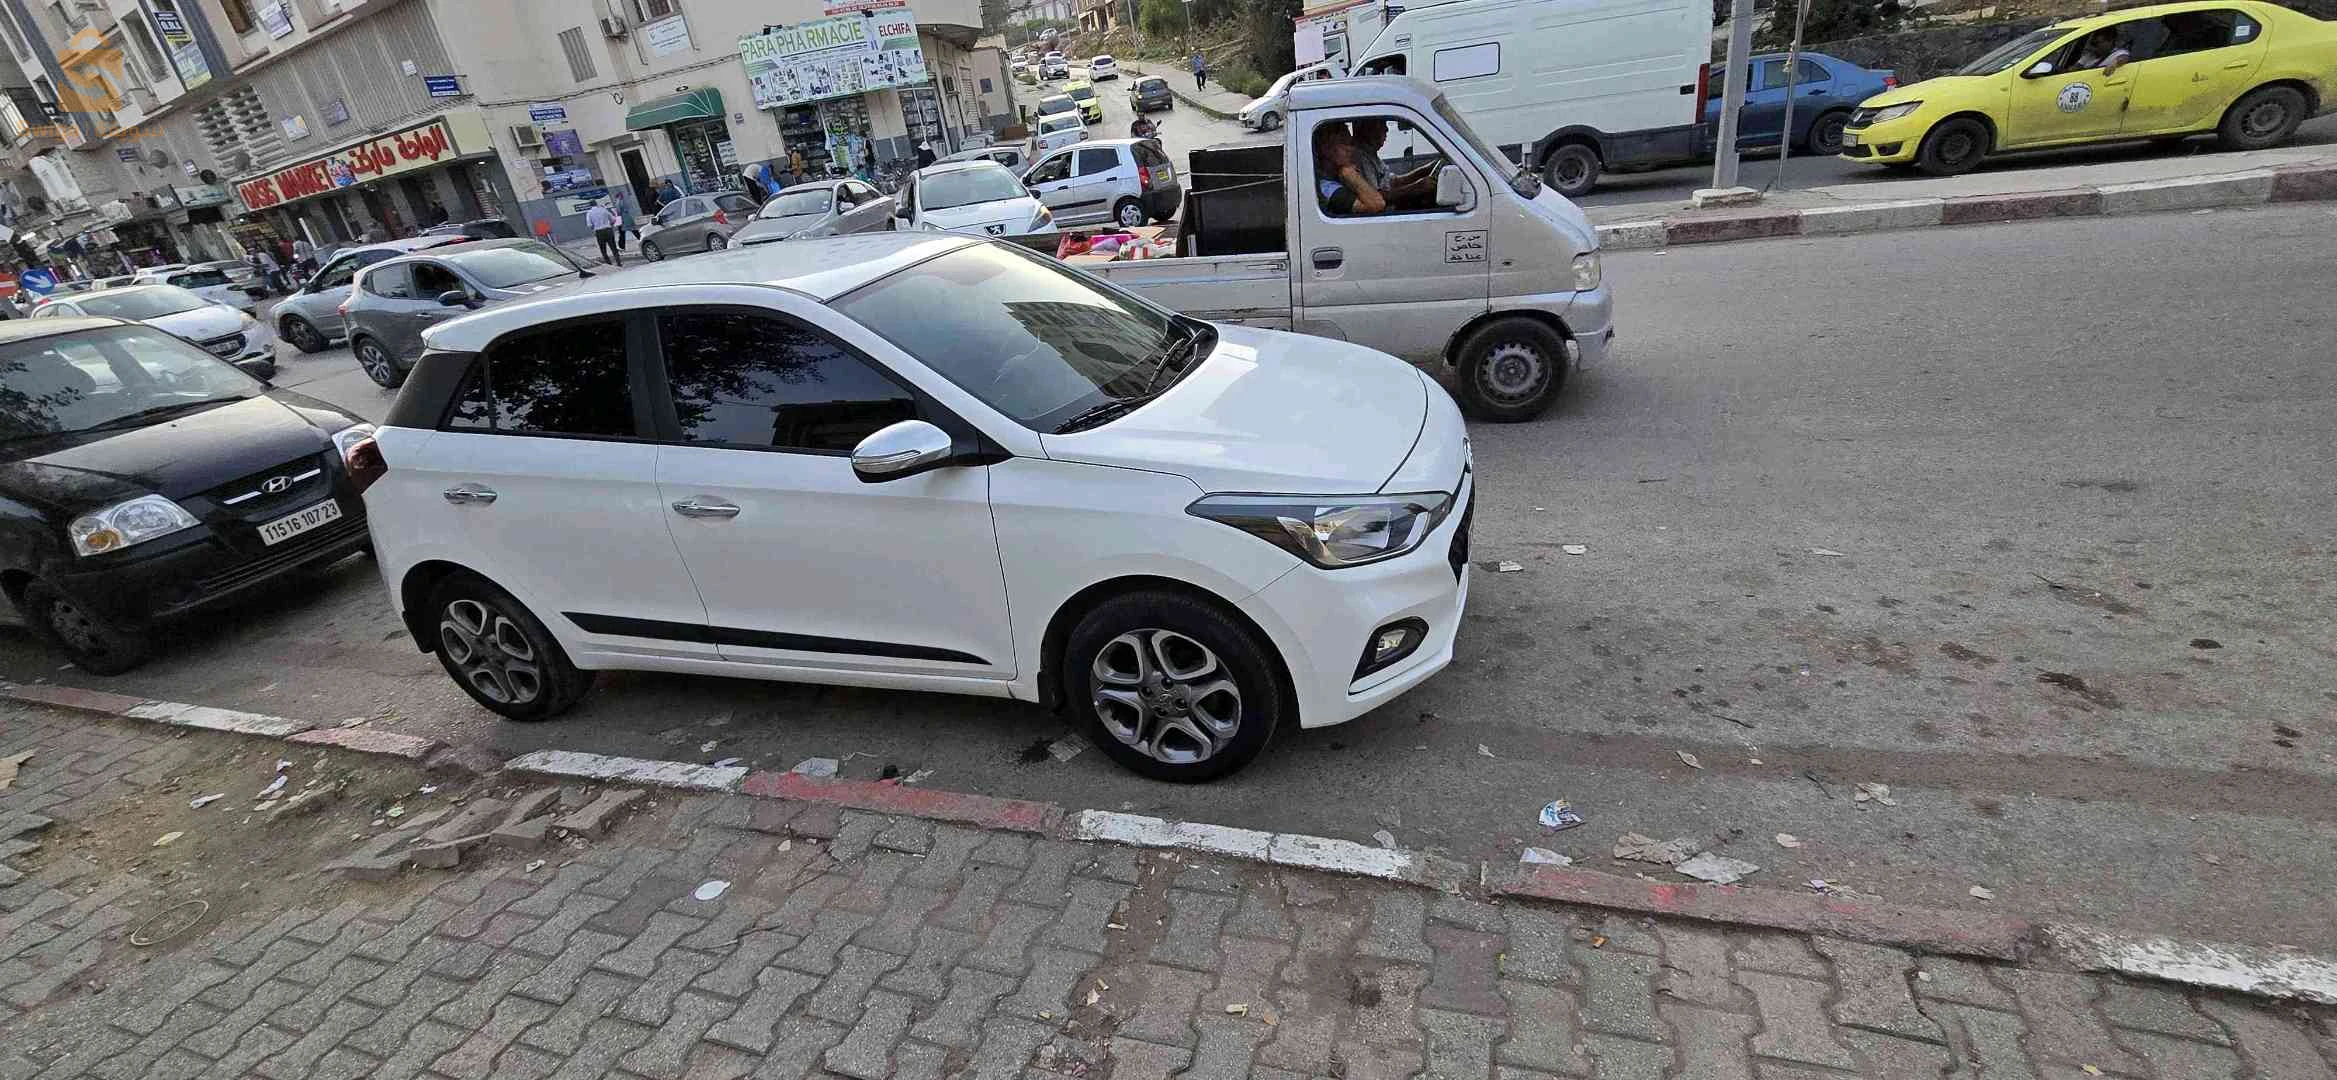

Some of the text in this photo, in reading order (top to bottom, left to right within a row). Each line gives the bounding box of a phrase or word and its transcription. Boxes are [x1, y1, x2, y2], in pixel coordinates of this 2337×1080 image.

[347, 124, 448, 176] الواحة ماركت
[239, 159, 336, 209] OASIS MARKET
[265, 501, 338, 541] 11516 107 23
